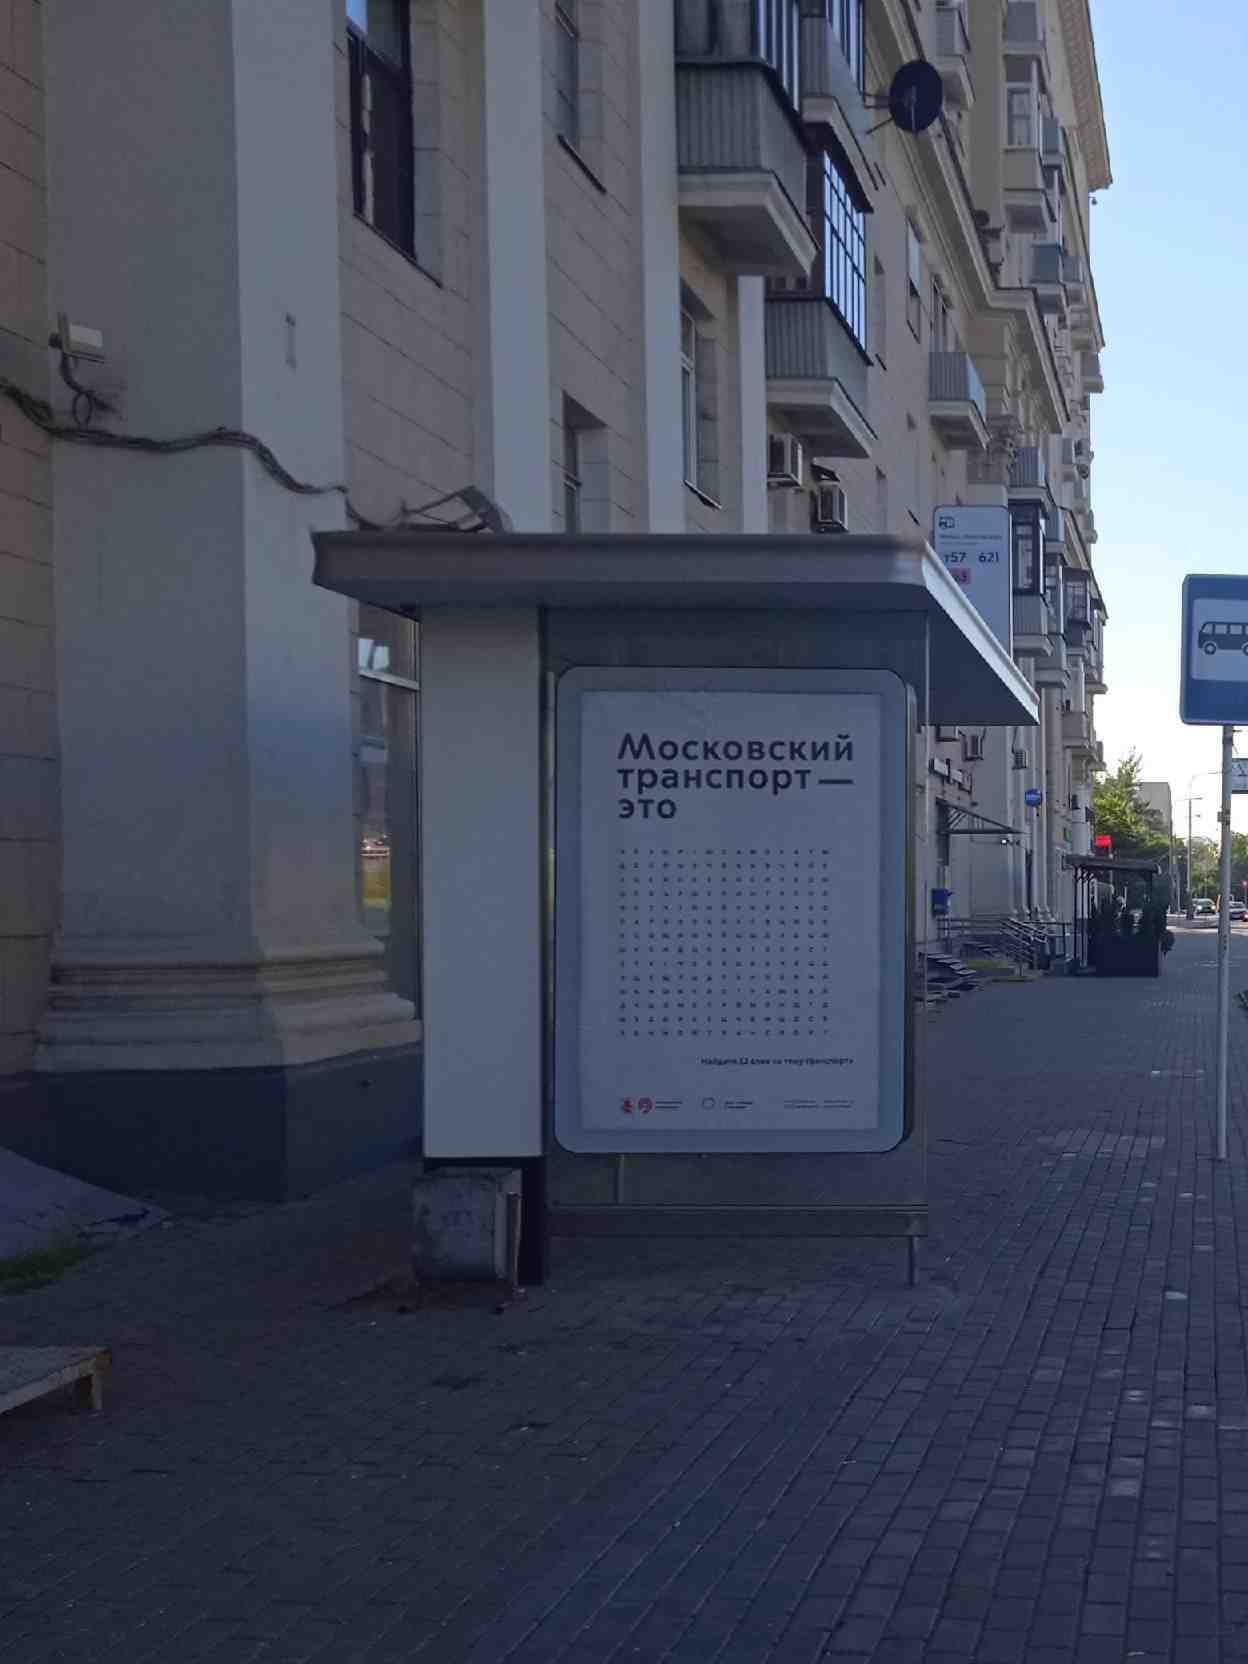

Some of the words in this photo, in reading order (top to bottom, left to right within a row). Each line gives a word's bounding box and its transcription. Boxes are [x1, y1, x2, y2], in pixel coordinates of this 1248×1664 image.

[978, 551, 1000, 563] 621
[616, 732, 854, 761] Московский
[617, 798, 678, 819] это
